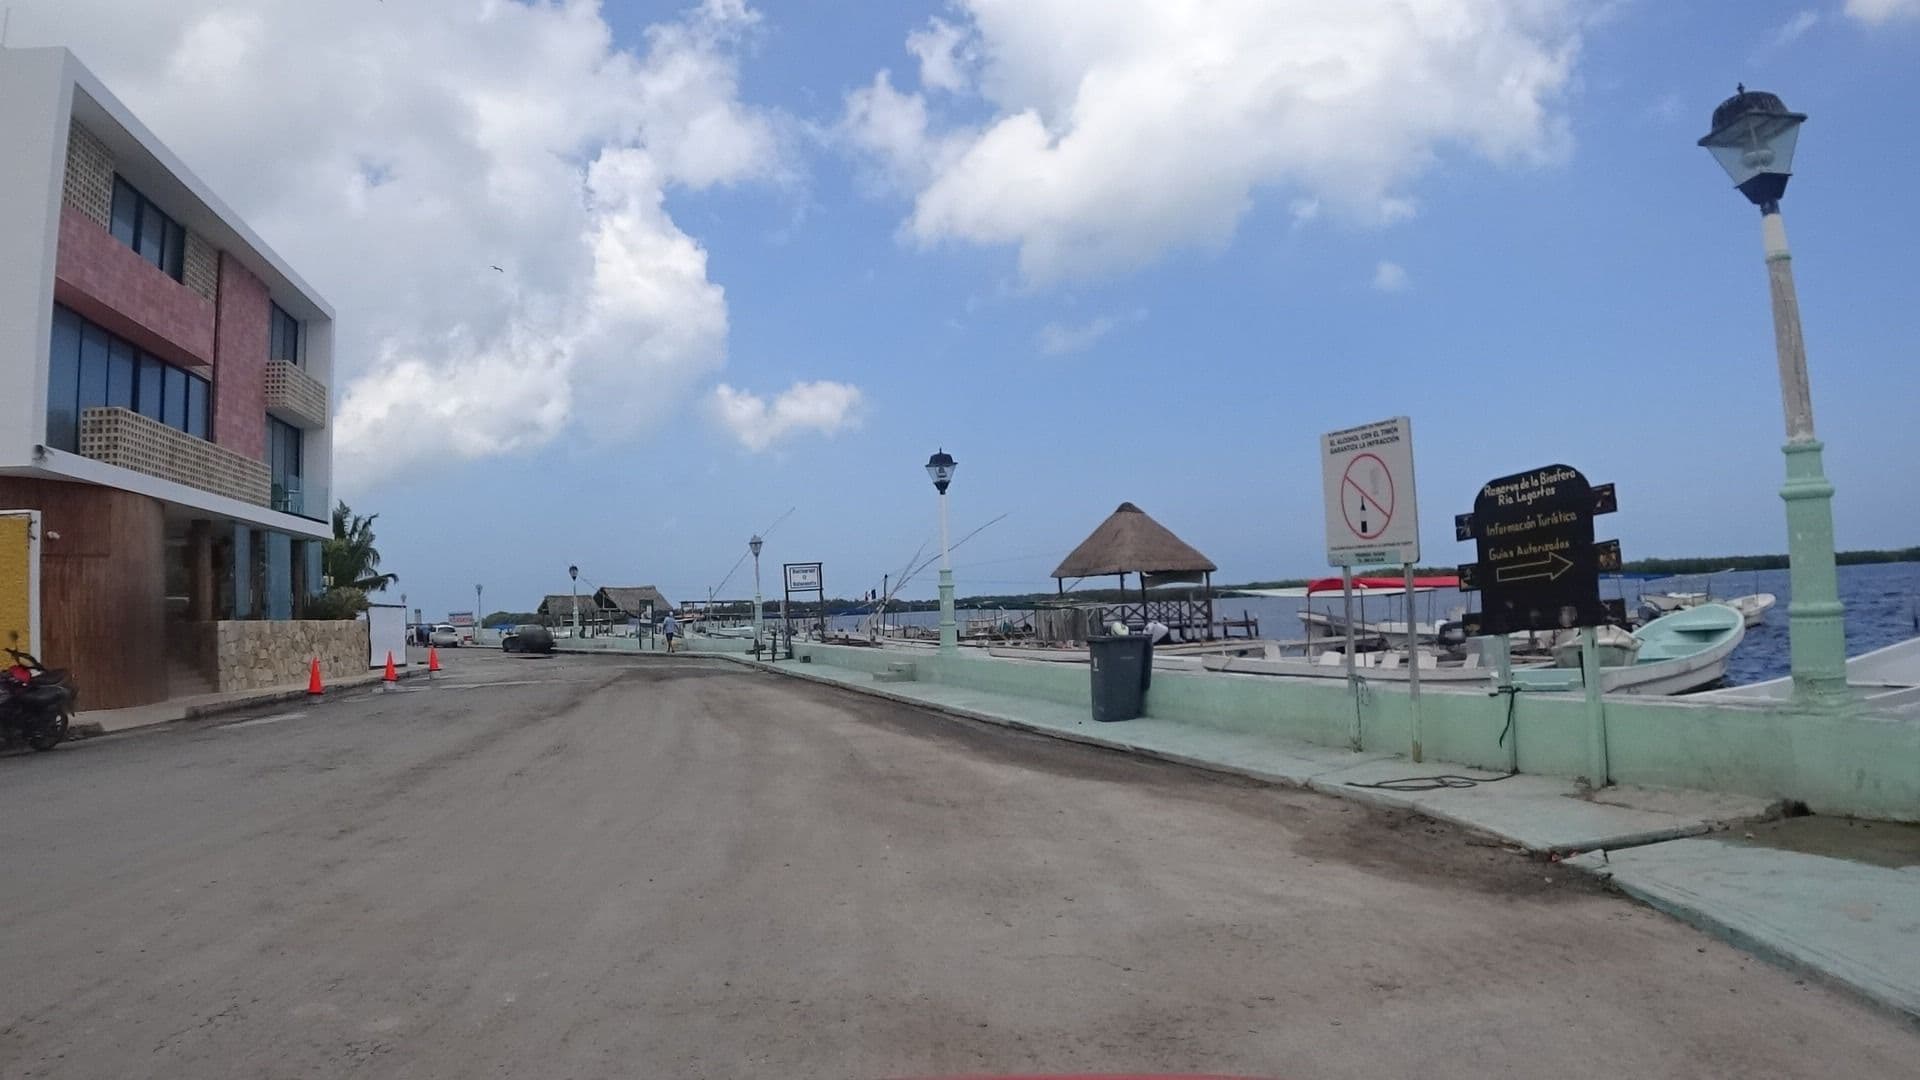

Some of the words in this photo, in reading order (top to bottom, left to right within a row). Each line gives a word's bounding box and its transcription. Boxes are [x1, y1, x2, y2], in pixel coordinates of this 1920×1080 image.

[1361, 432, 1372, 440] CON
[1484, 483, 1520, 497] Reserva
[1520, 477, 1530, 490] de
[1530, 475, 1539, 487] la
[1540, 469, 1576, 485] Biosfera
[1516, 487, 1556, 505] Lagartos
[1517, 537, 1570, 556] Autorizados
